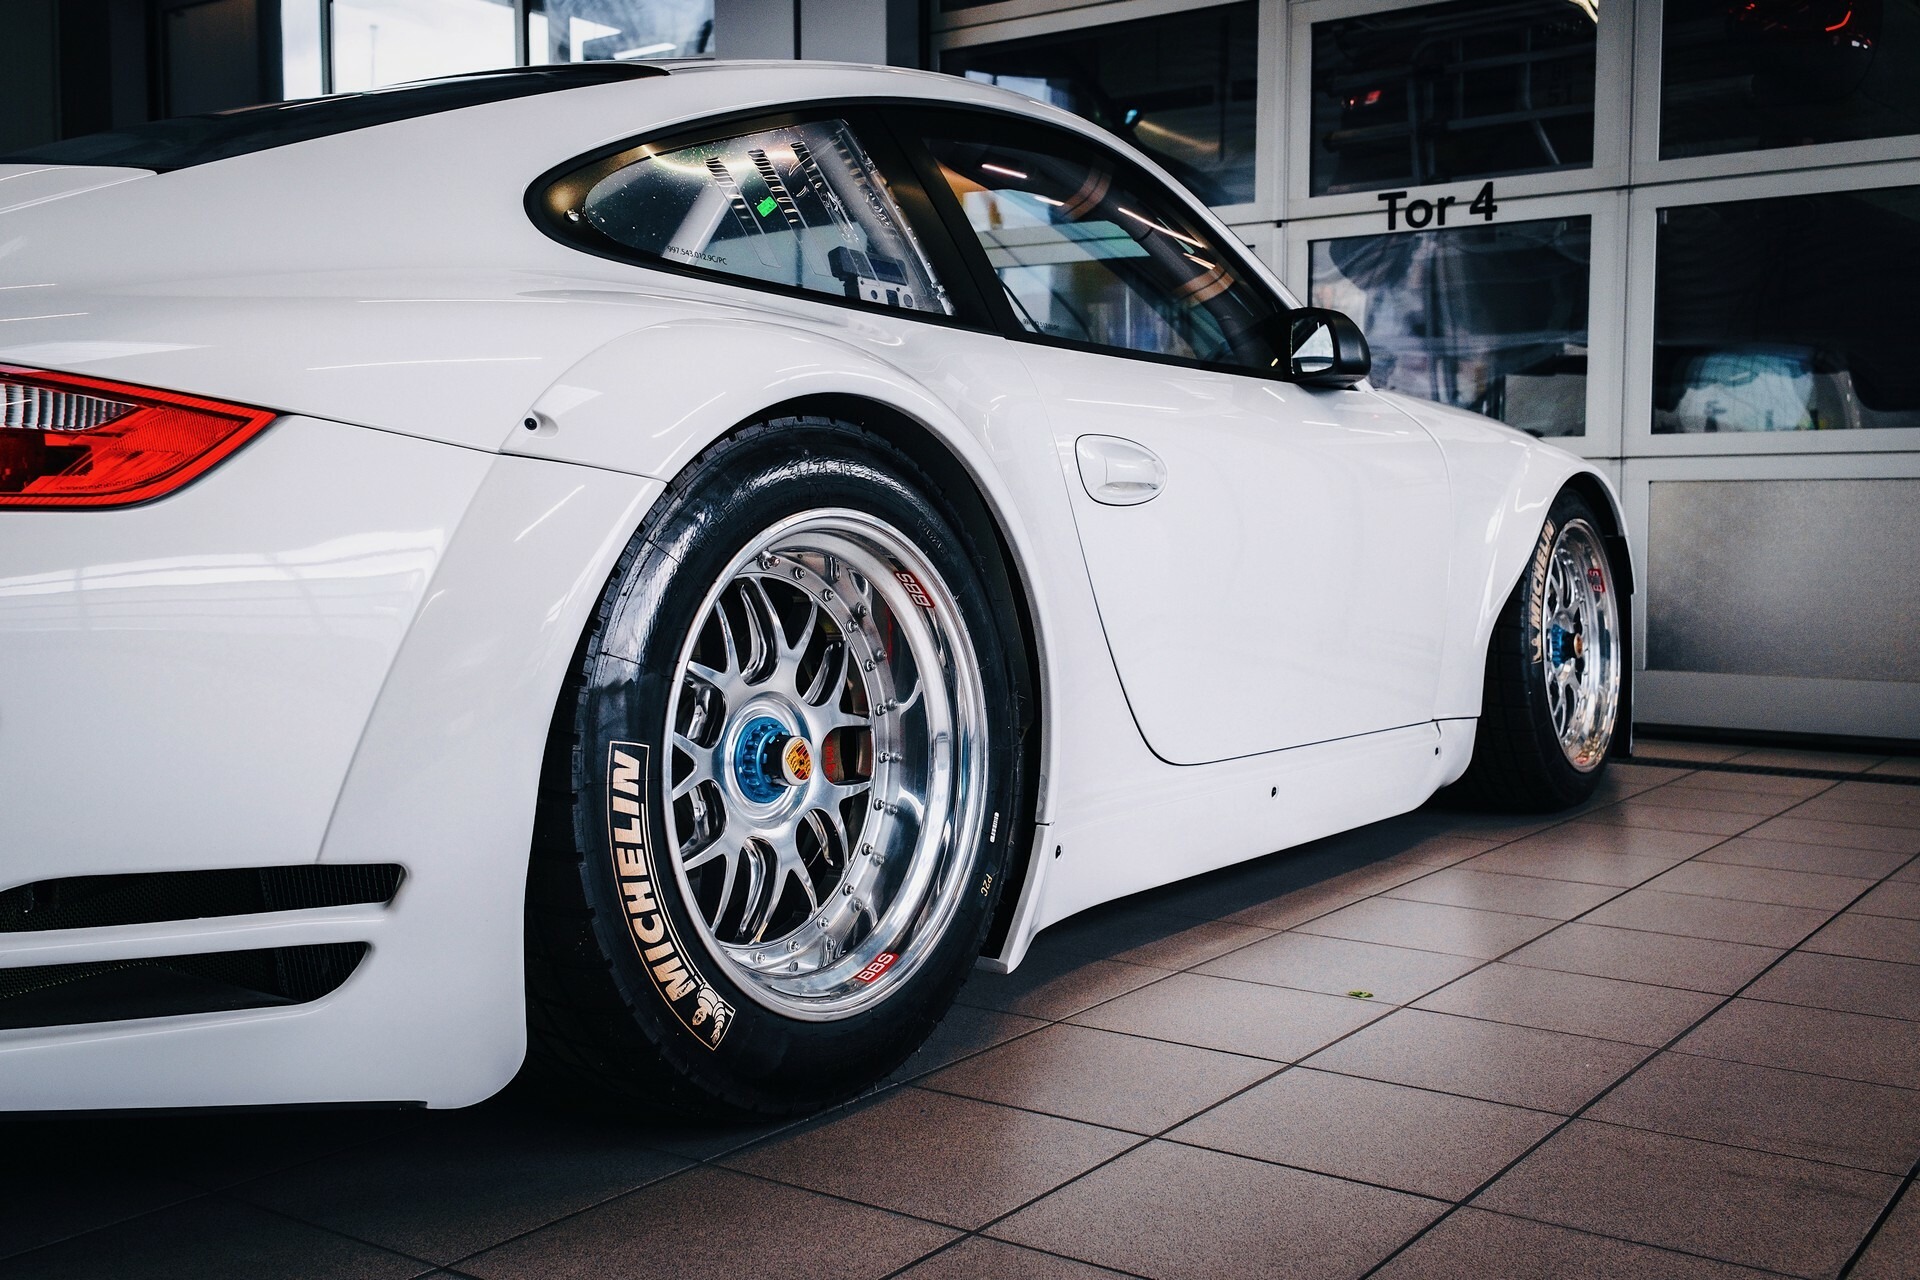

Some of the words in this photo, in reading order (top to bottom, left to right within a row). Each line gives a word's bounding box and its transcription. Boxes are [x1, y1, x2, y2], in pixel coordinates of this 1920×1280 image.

[1377, 190, 1456, 231] Tor
[1469, 181, 1498, 222] 4
[895, 572, 932, 607] BBS
[1530, 519, 1556, 632] MICHELIN
[1589, 570, 1603, 592] BS
[612, 750, 697, 1002] MICHELIN
[856, 952, 894, 981] BBS
